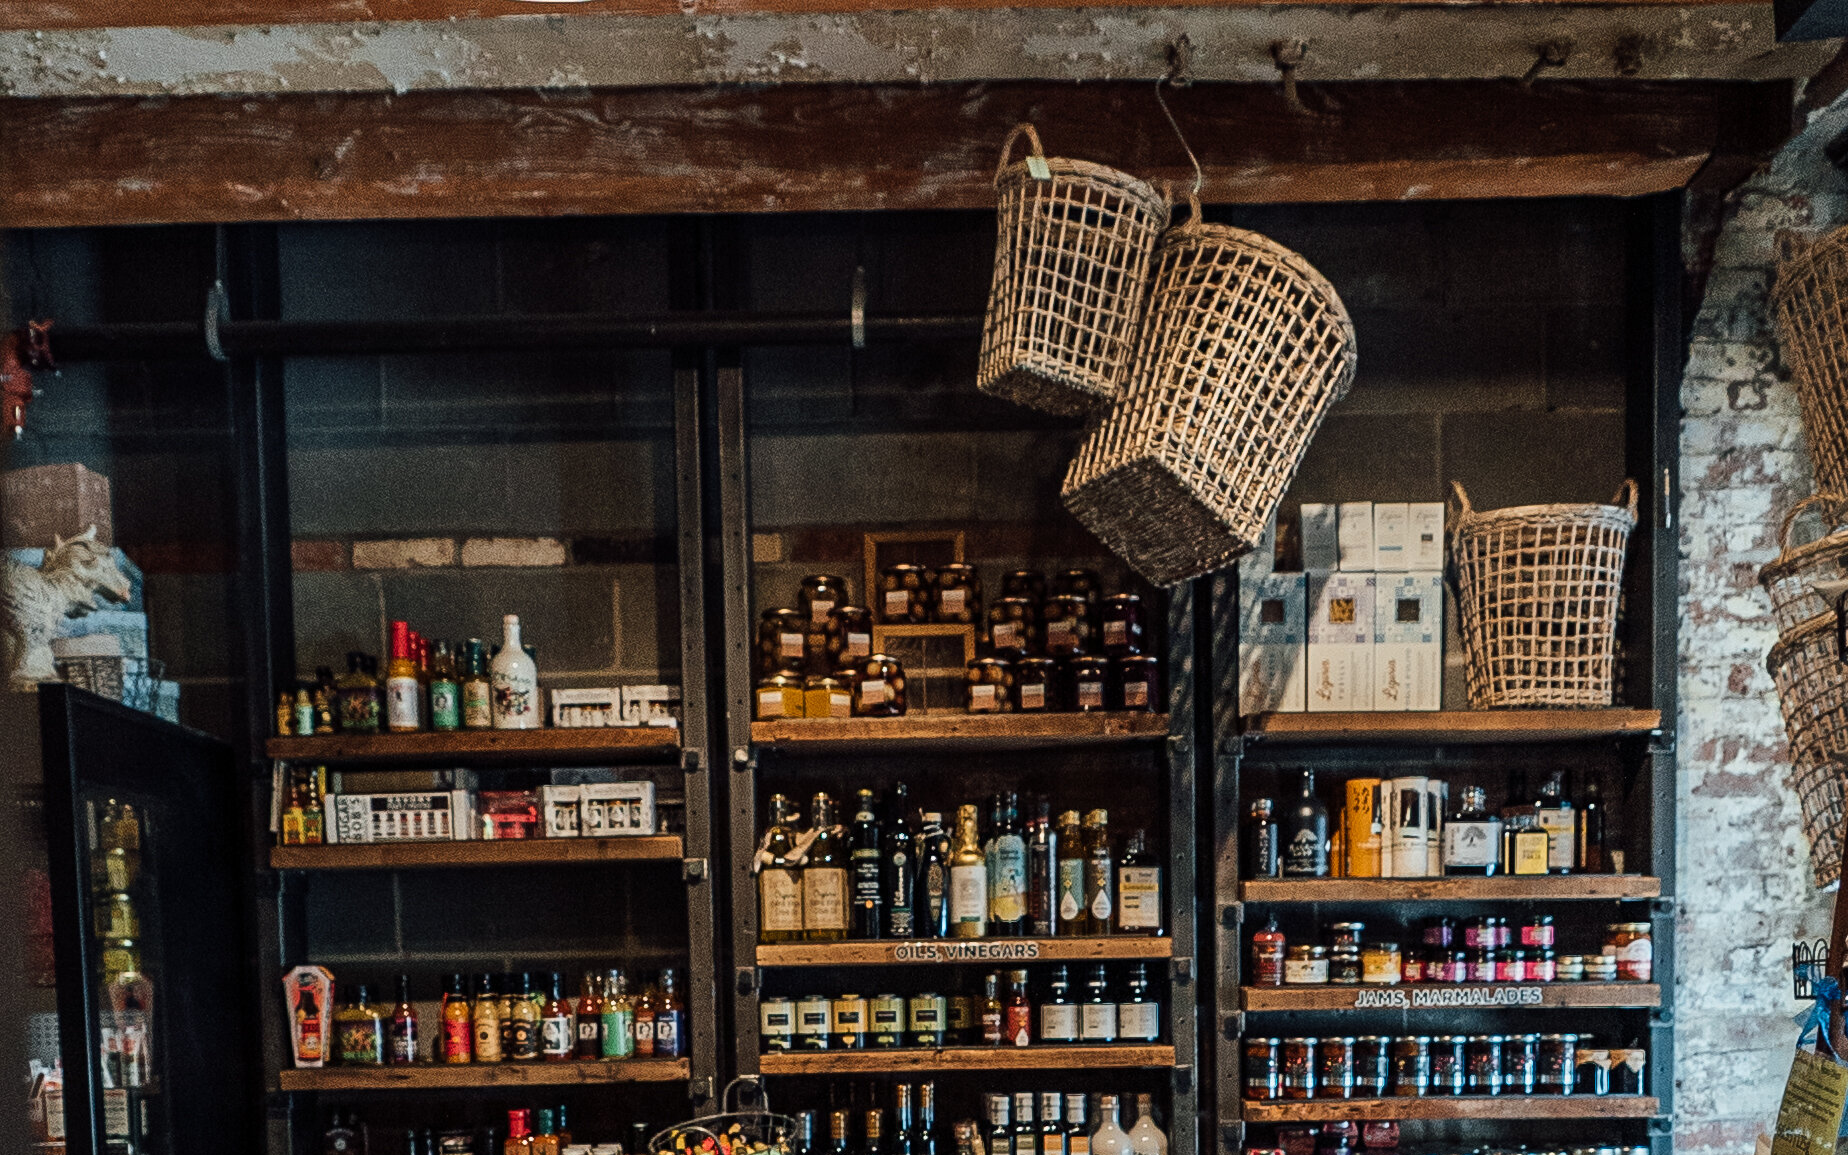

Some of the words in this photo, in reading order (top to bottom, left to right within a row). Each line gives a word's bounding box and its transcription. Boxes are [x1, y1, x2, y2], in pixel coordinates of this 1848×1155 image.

[895, 944, 943, 962] OILS,
[944, 943, 1038, 960] VINEGARS
[1356, 989, 1410, 1009] JAMS,
[1413, 987, 1543, 1006] MARMALADES
